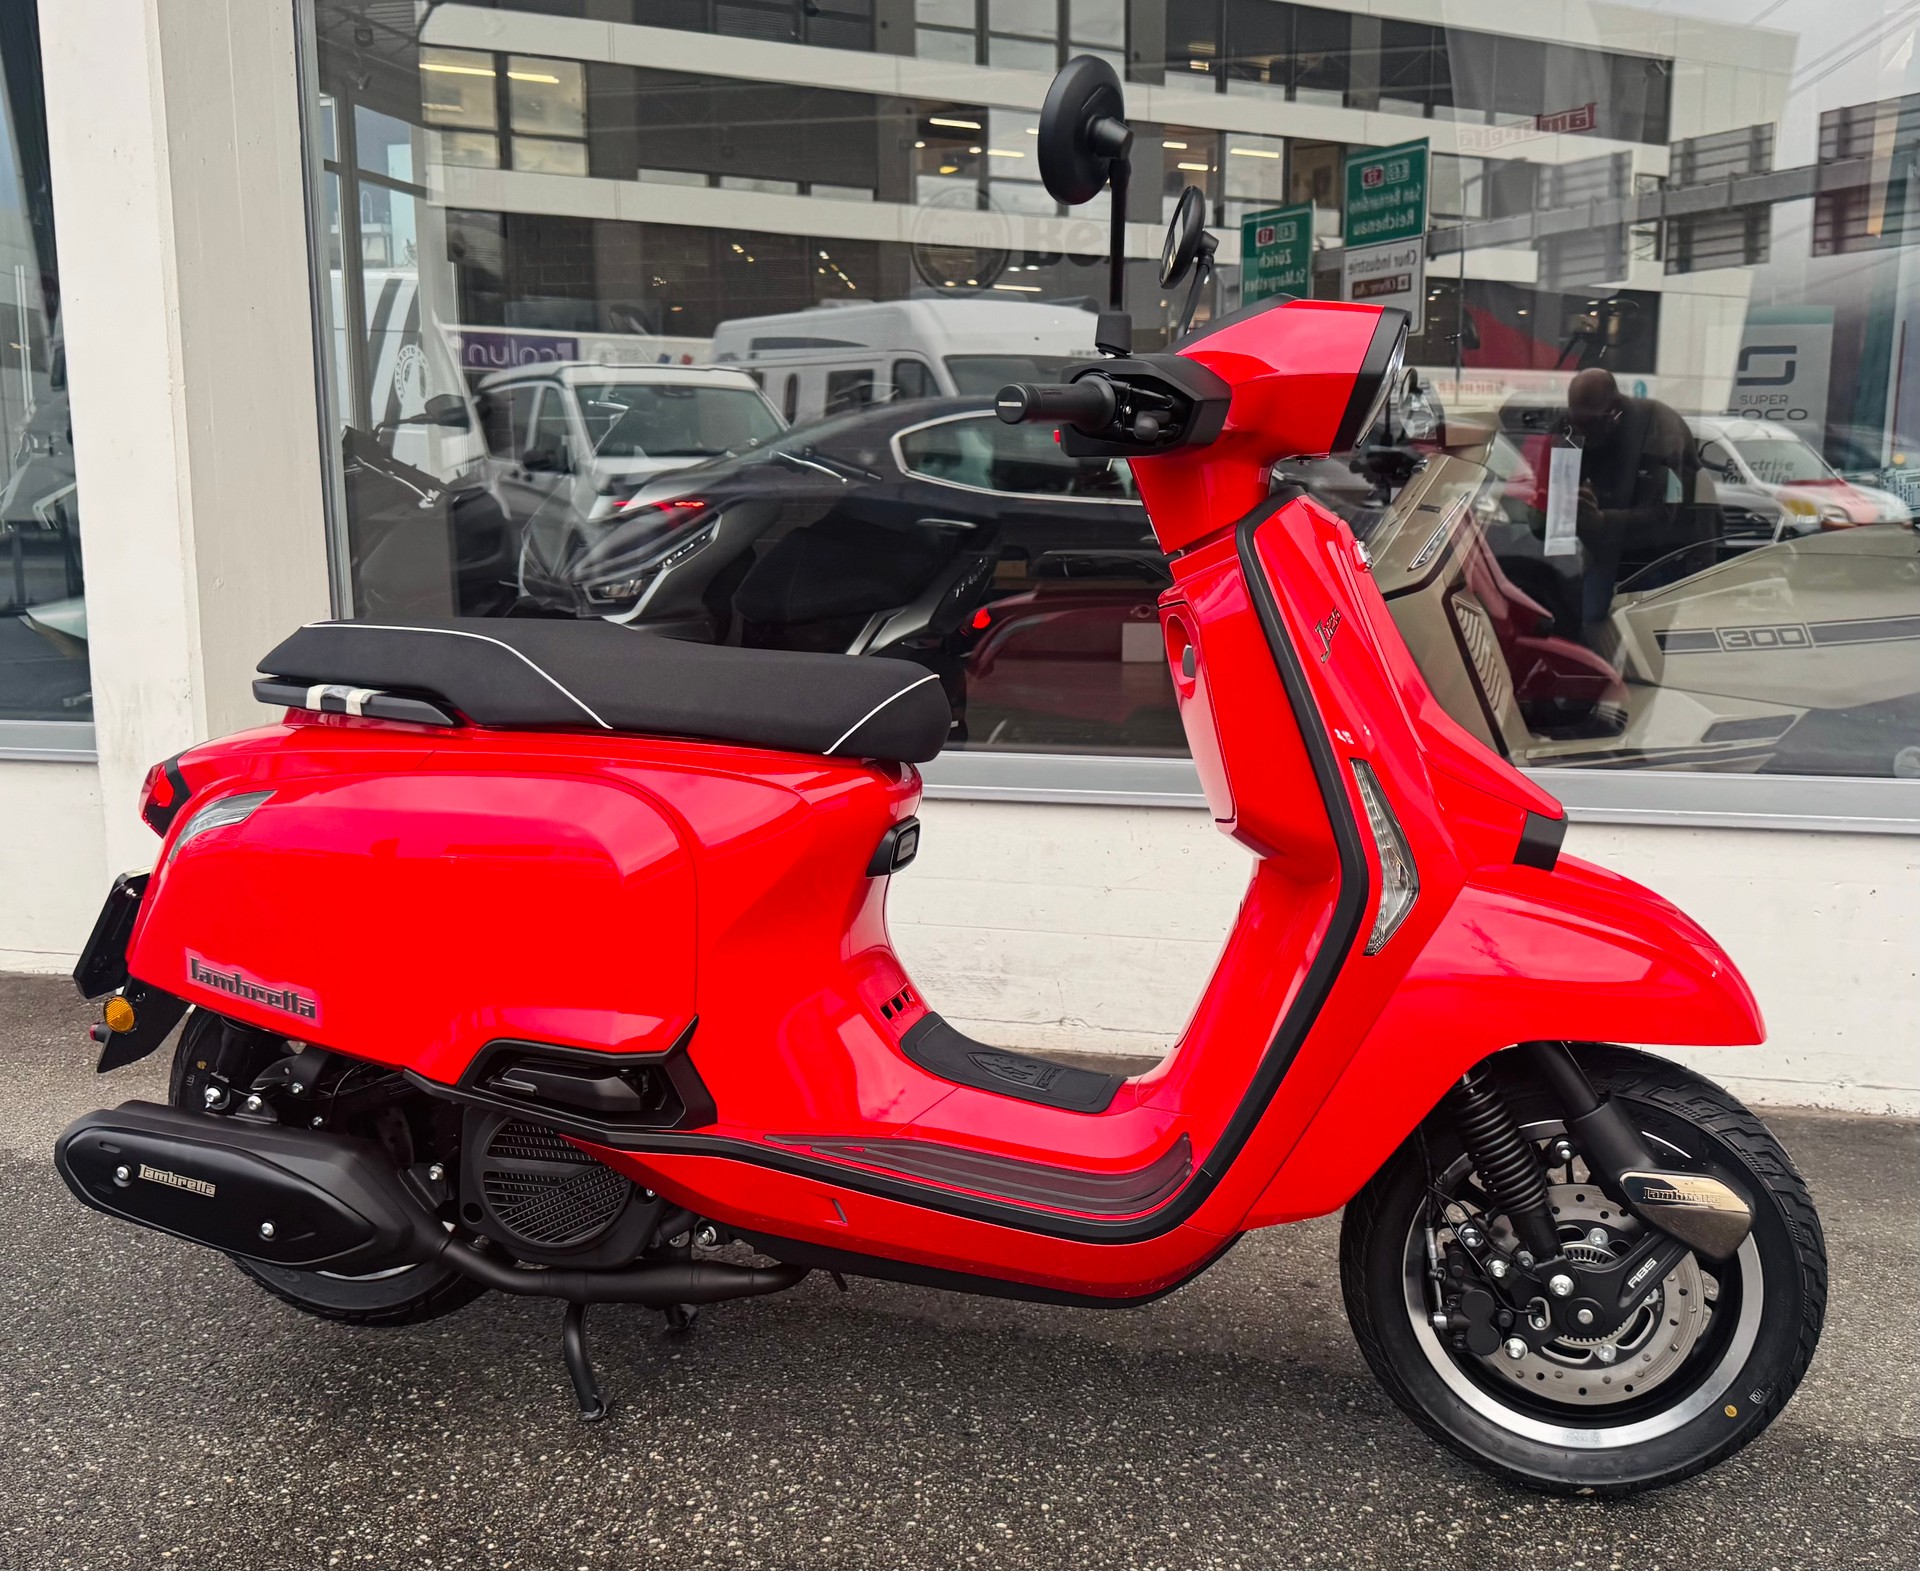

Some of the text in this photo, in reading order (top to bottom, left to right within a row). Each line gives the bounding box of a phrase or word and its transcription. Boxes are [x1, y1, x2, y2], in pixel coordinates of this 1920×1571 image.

[1740, 394, 1789, 406] SUPER
[1722, 627, 1807, 649] 300
[1627, 1257, 1658, 1289] ABS
